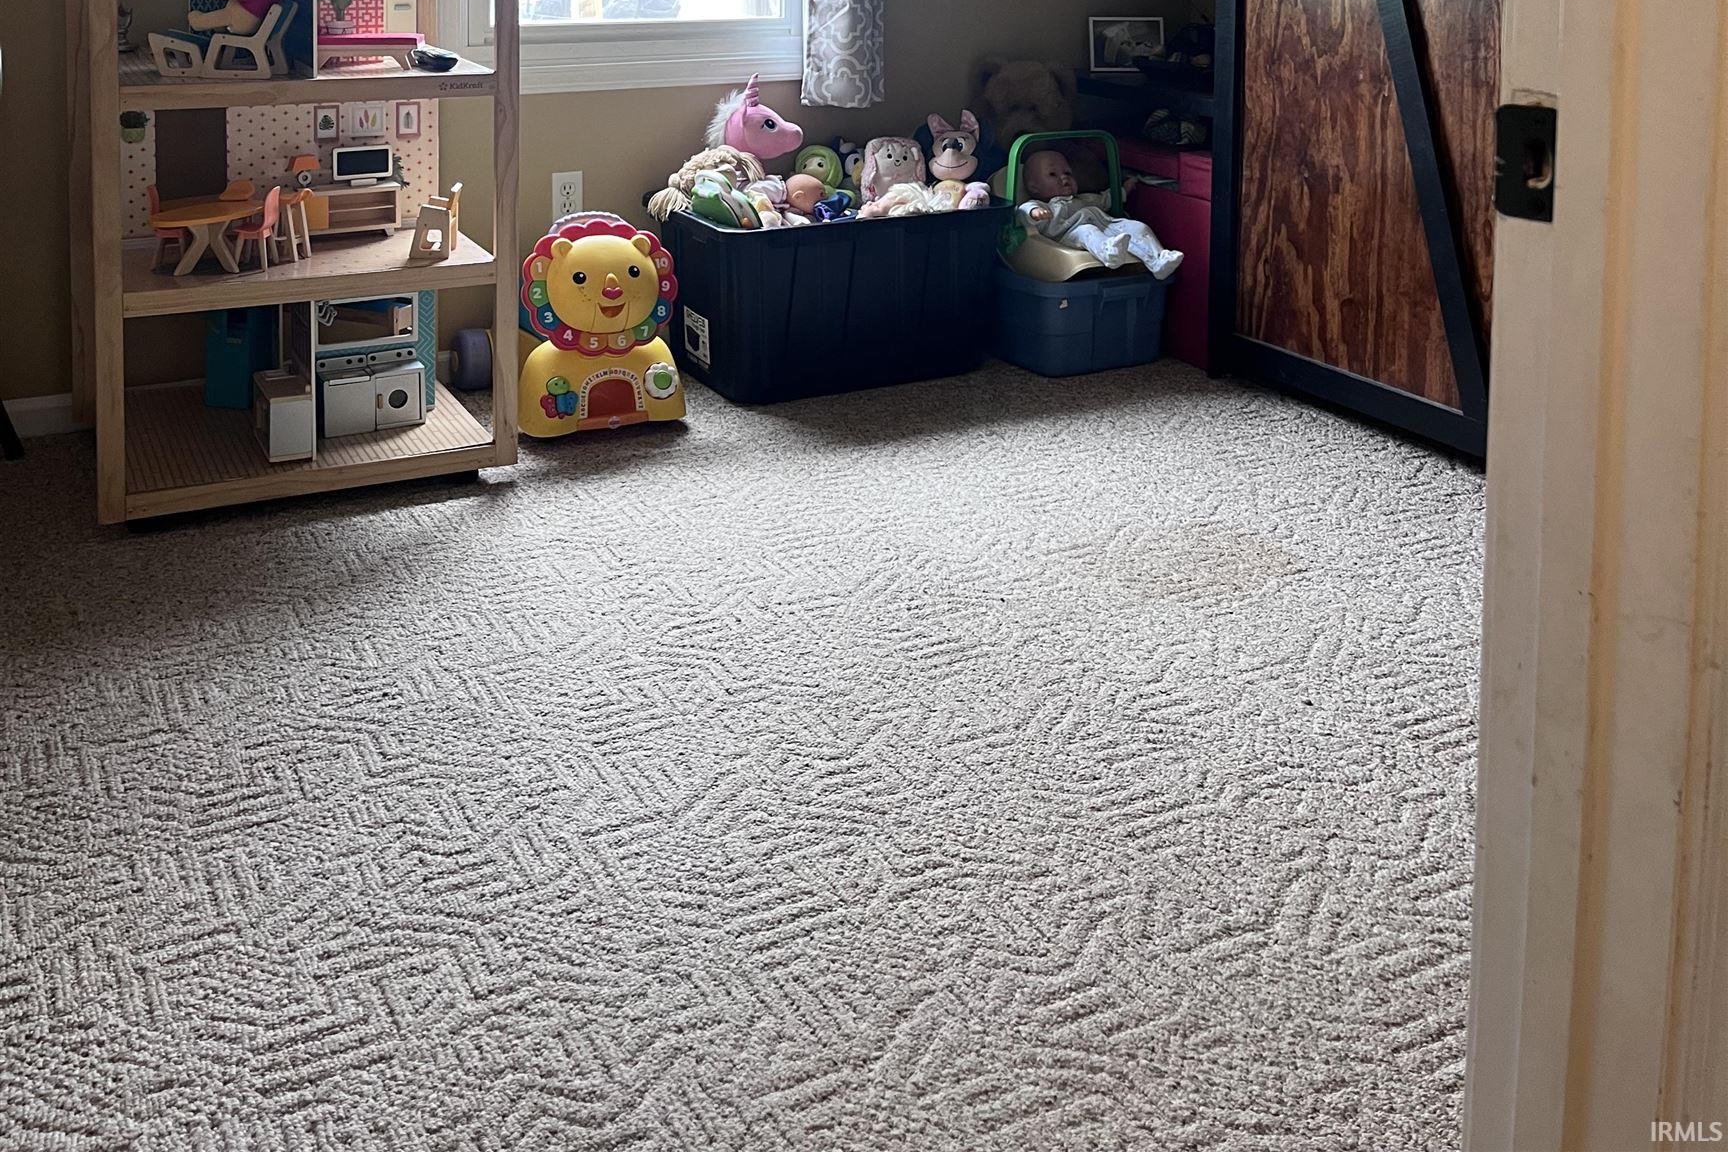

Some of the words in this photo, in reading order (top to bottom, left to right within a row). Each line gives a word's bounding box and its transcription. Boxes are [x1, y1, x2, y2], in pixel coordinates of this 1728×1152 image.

[449, 81, 483, 89] KidKraft
[536, 261, 544, 273] 1
[654, 257, 668, 269] 10
[661, 280, 670, 291] 9
[533, 288, 542, 299] 2
[544, 311, 554, 323] 3
[657, 305, 666, 317] 8
[563, 329, 573, 341] 4
[640, 325, 649, 337] 7
[589, 337, 599, 348] 5
[617, 334, 626, 346] 6
